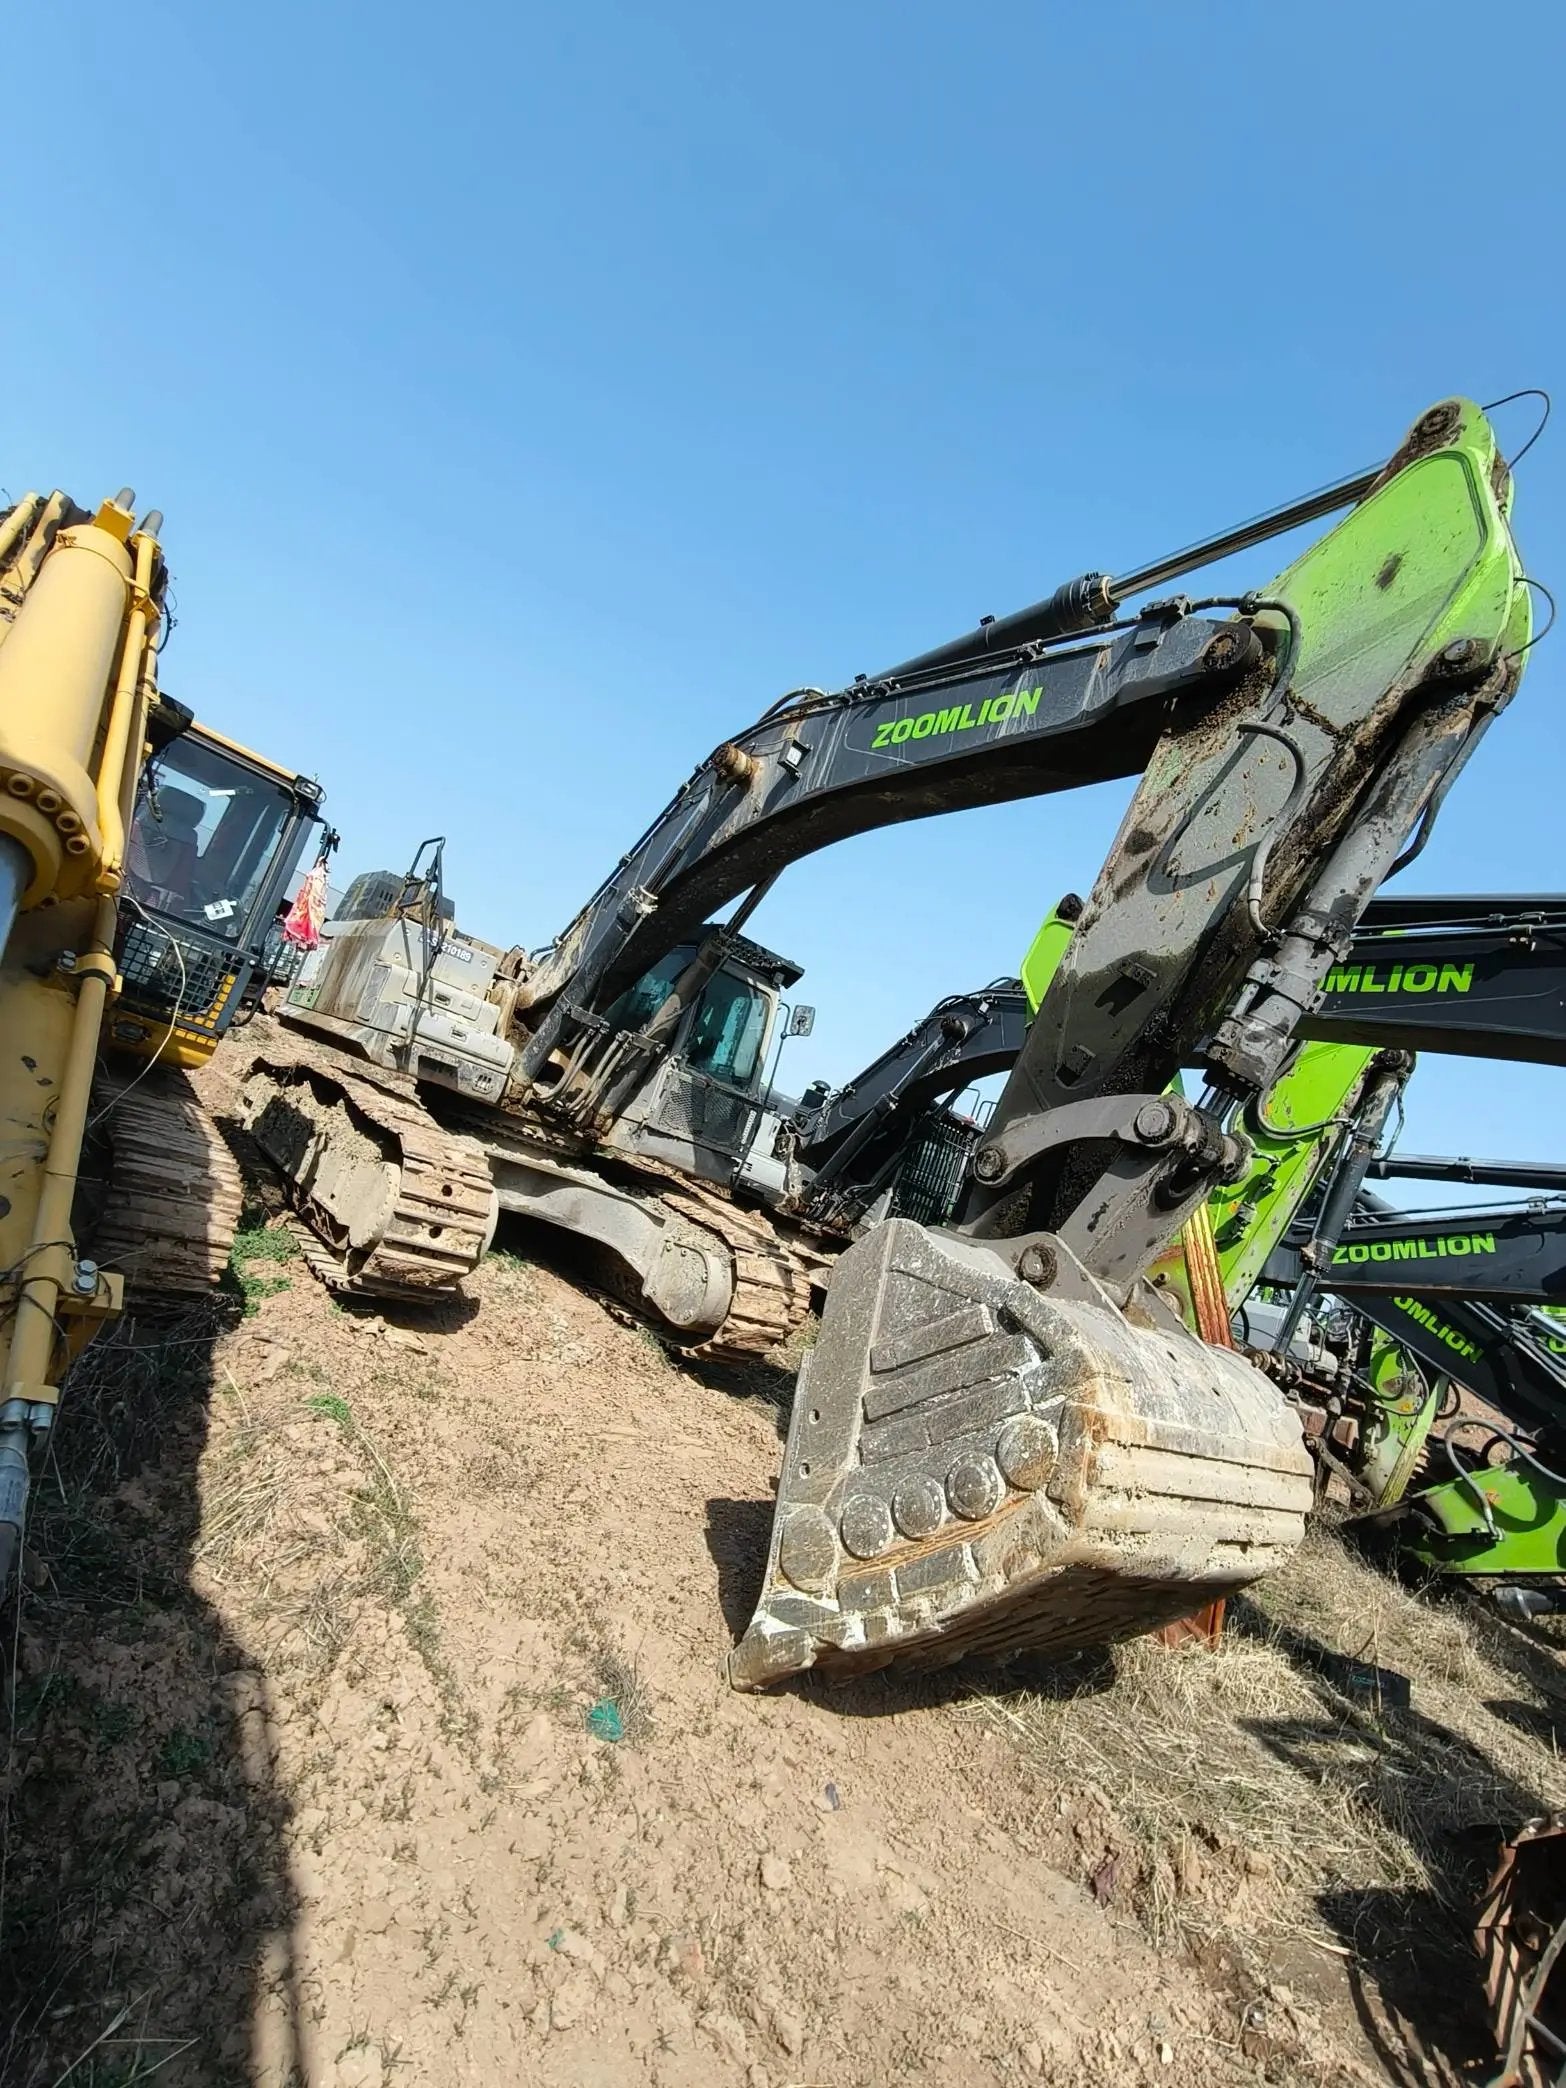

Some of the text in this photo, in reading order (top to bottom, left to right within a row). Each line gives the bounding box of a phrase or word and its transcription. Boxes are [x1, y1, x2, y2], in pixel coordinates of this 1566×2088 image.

[872, 687, 1043, 748] ZOOMLION
[1317, 963, 1475, 993] MLION
[1331, 1232, 1496, 1265] ZOOMLION
[1393, 1296, 1484, 1364] OMLION
